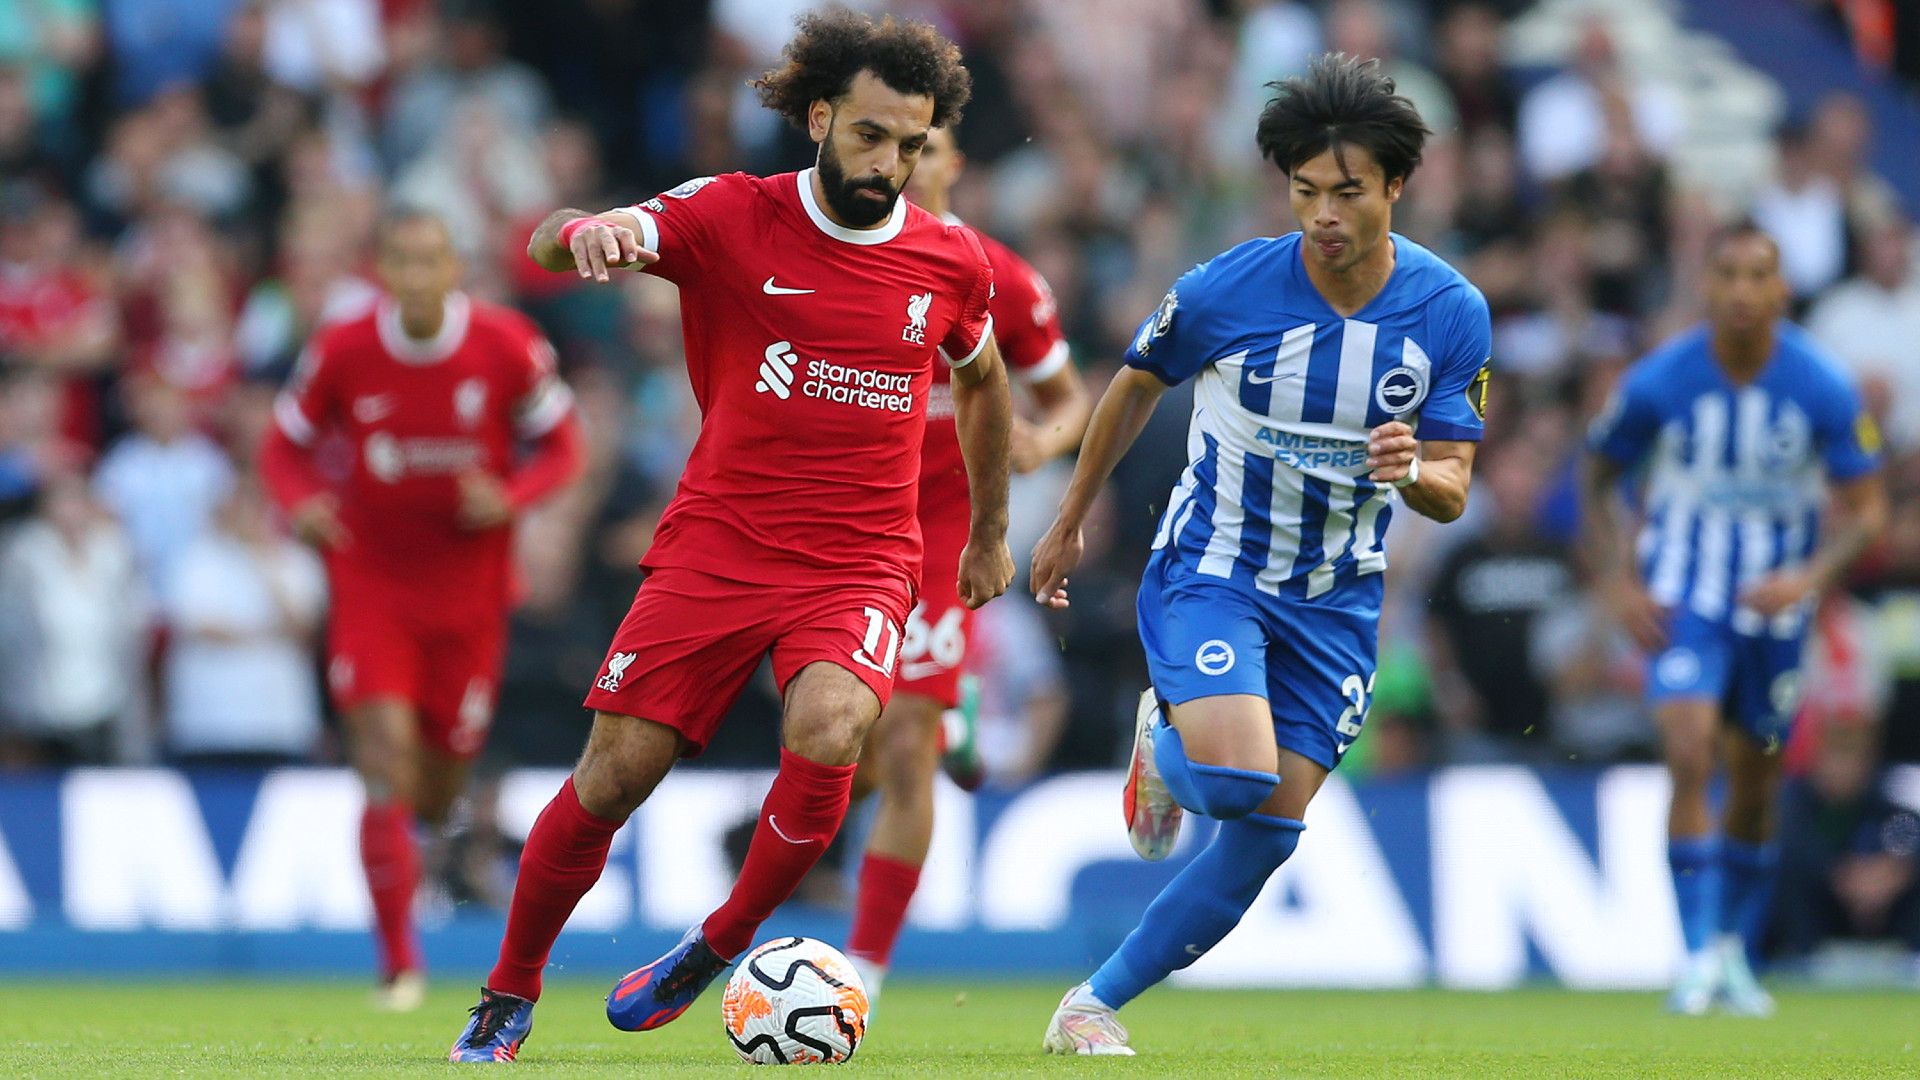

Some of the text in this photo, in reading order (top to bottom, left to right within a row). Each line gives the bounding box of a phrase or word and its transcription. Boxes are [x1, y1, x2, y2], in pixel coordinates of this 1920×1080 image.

[803, 379, 913, 413] chartered
[806, 359, 912, 393] standard
[863, 606, 899, 675] 11
[901, 600, 966, 668] 66
[1336, 671, 1377, 737] 2
